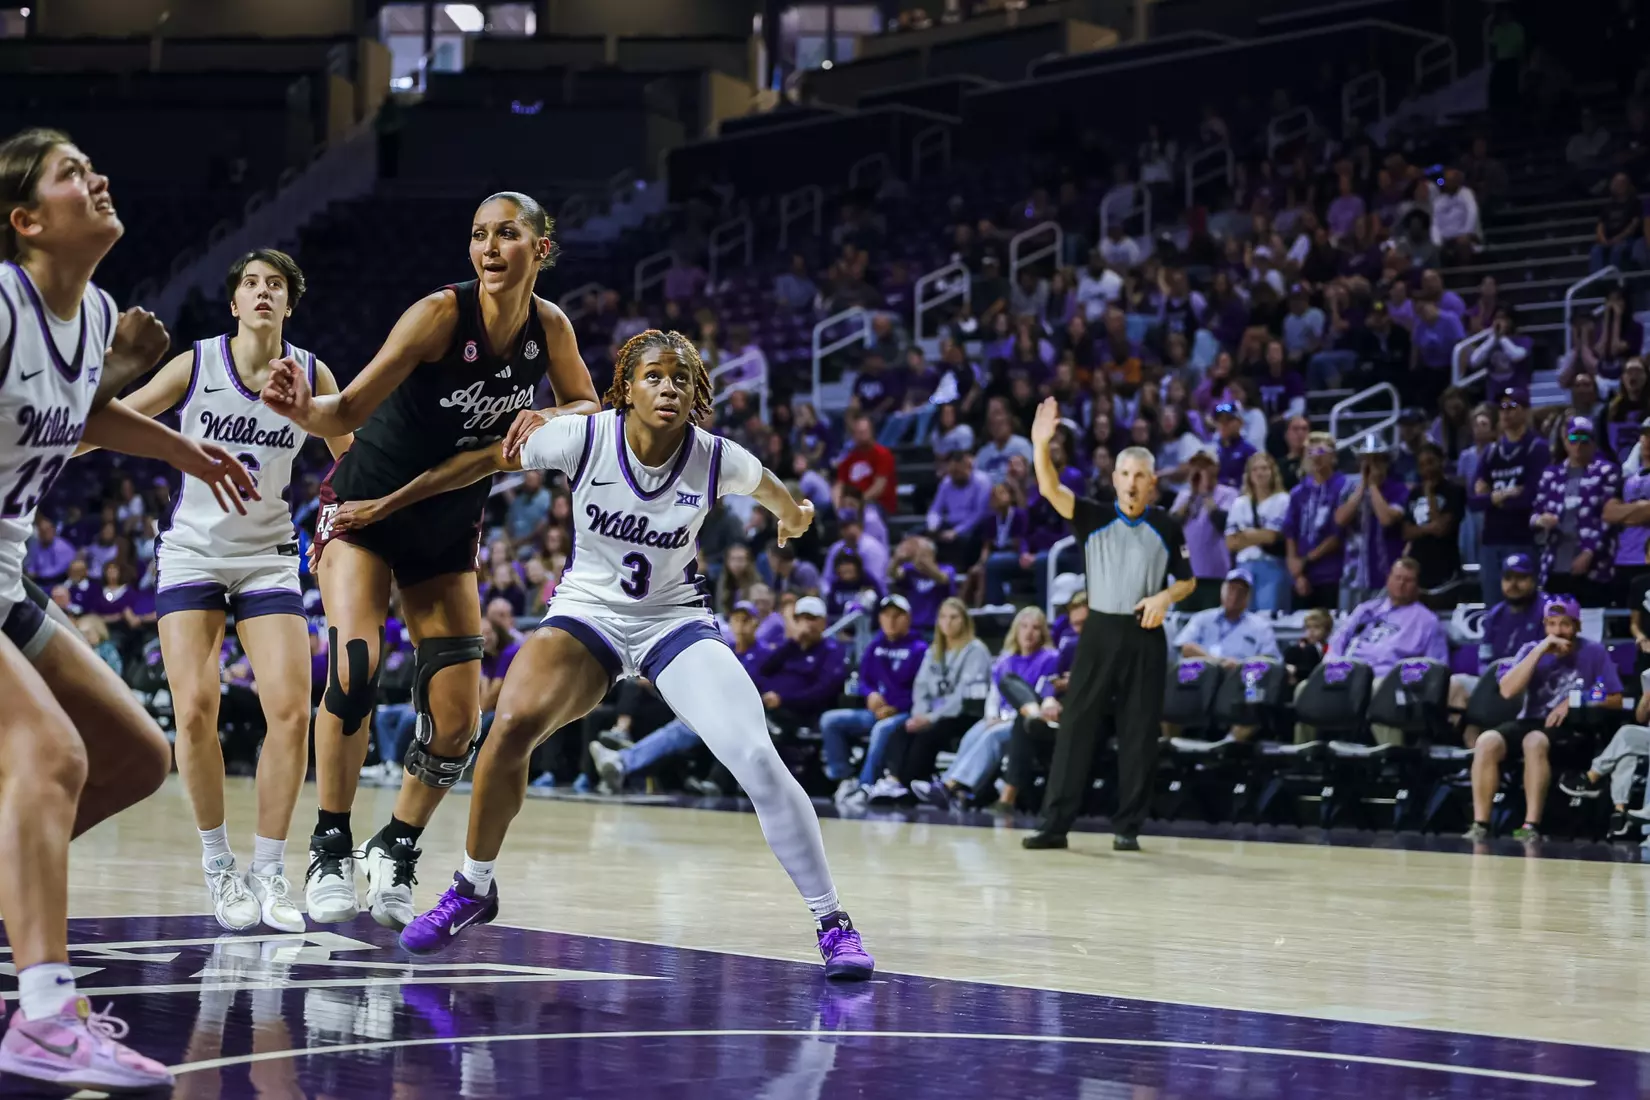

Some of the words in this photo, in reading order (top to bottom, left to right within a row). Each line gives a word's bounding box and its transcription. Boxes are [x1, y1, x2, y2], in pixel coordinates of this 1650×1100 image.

[16, 405, 86, 448] Wildca
[440, 380, 535, 430] Aggies
[201, 410, 295, 449] Wildcats
[1, 454, 65, 519] 23
[674, 490, 704, 509] XII
[586, 504, 690, 549] Wildcats
[620, 551, 652, 600] 3
